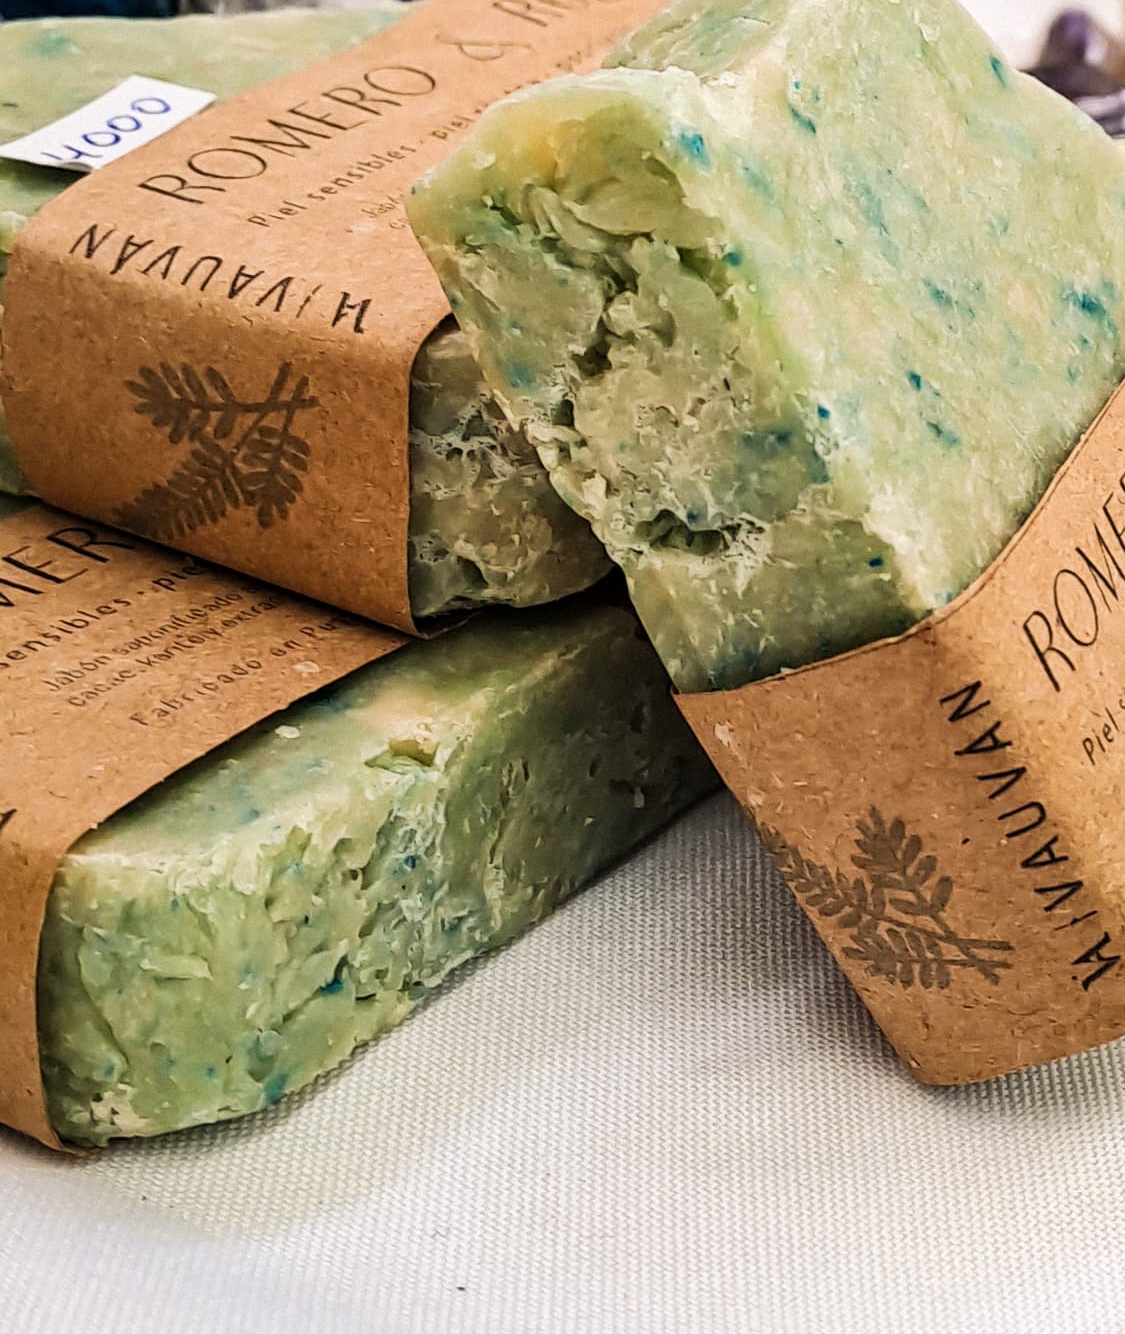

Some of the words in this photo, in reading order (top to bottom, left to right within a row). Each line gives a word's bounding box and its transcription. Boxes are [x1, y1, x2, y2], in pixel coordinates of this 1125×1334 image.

[39, 96, 172, 163] 4000
[137, 65, 437, 205] ROMERO
[247, 200, 307, 228] Piel
[307, 144, 417, 202] sensibles
[1081, 707, 1120, 766] Piel
